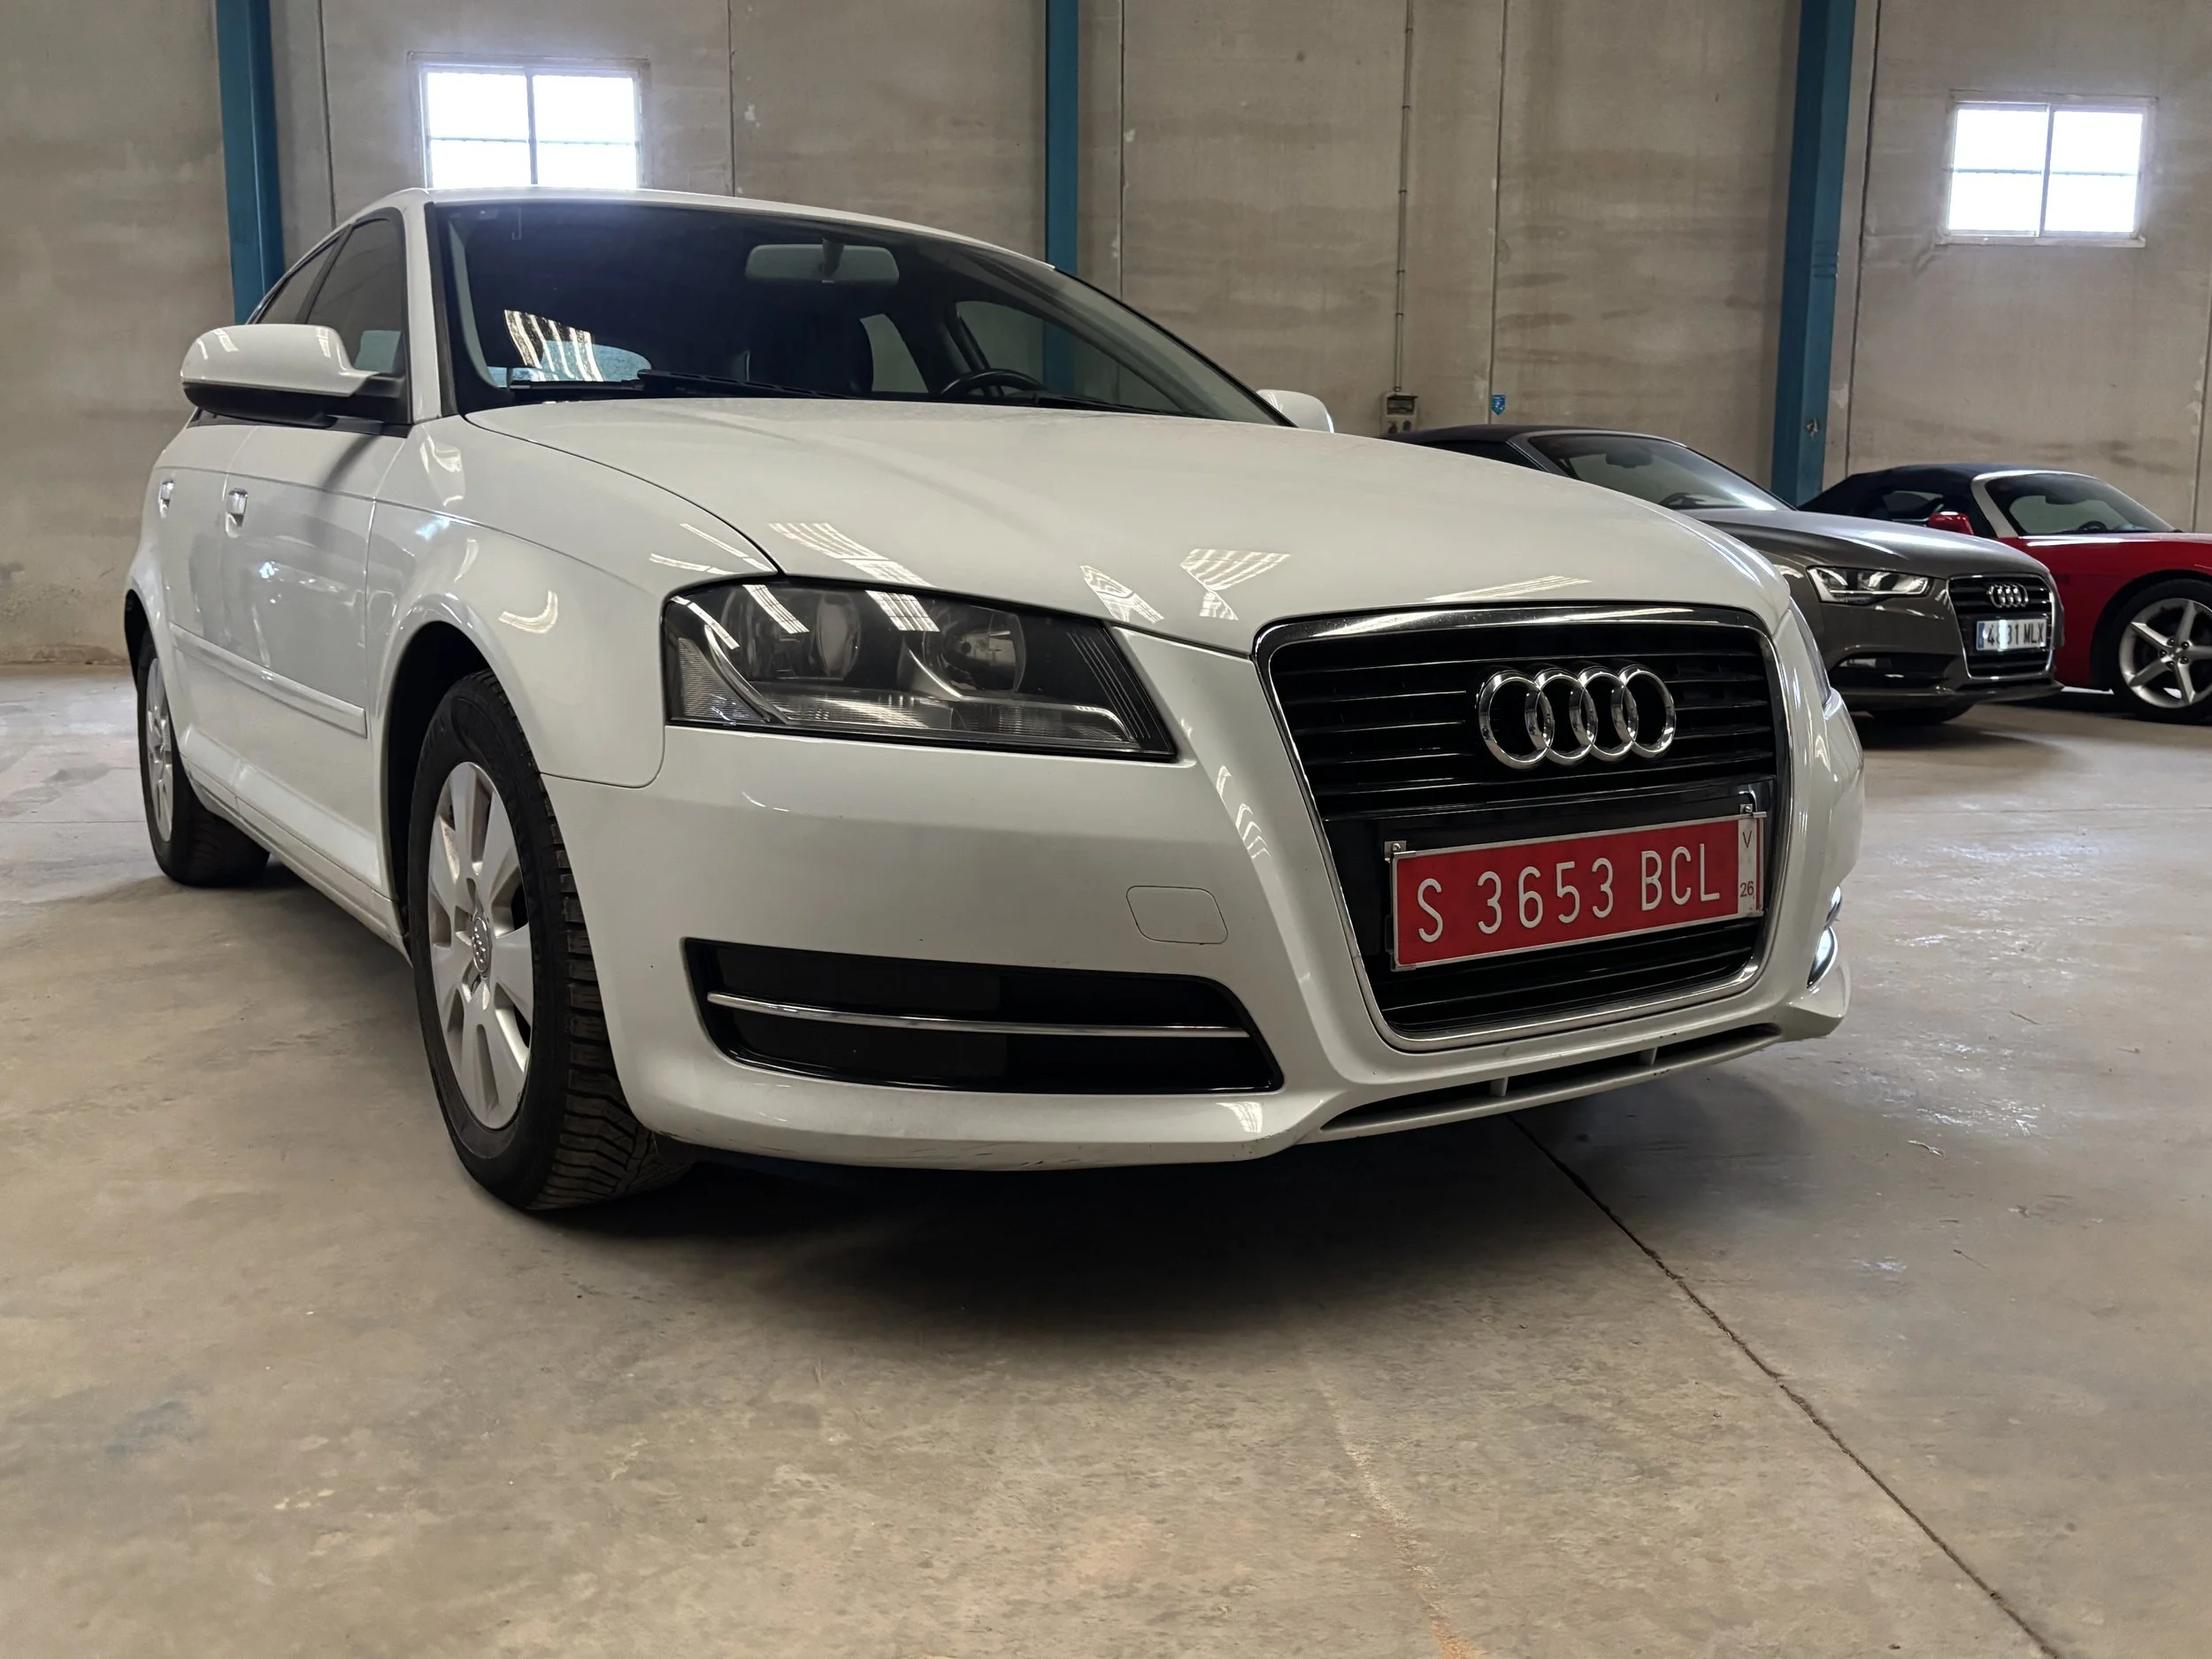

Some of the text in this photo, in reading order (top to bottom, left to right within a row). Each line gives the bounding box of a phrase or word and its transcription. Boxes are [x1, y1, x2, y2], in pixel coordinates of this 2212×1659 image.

[2024, 622, 2044, 644] MLX
[1742, 830, 1752, 849] V
[1417, 842, 1720, 943] S 3653 BCL
[1740, 880, 1755, 898] 26
